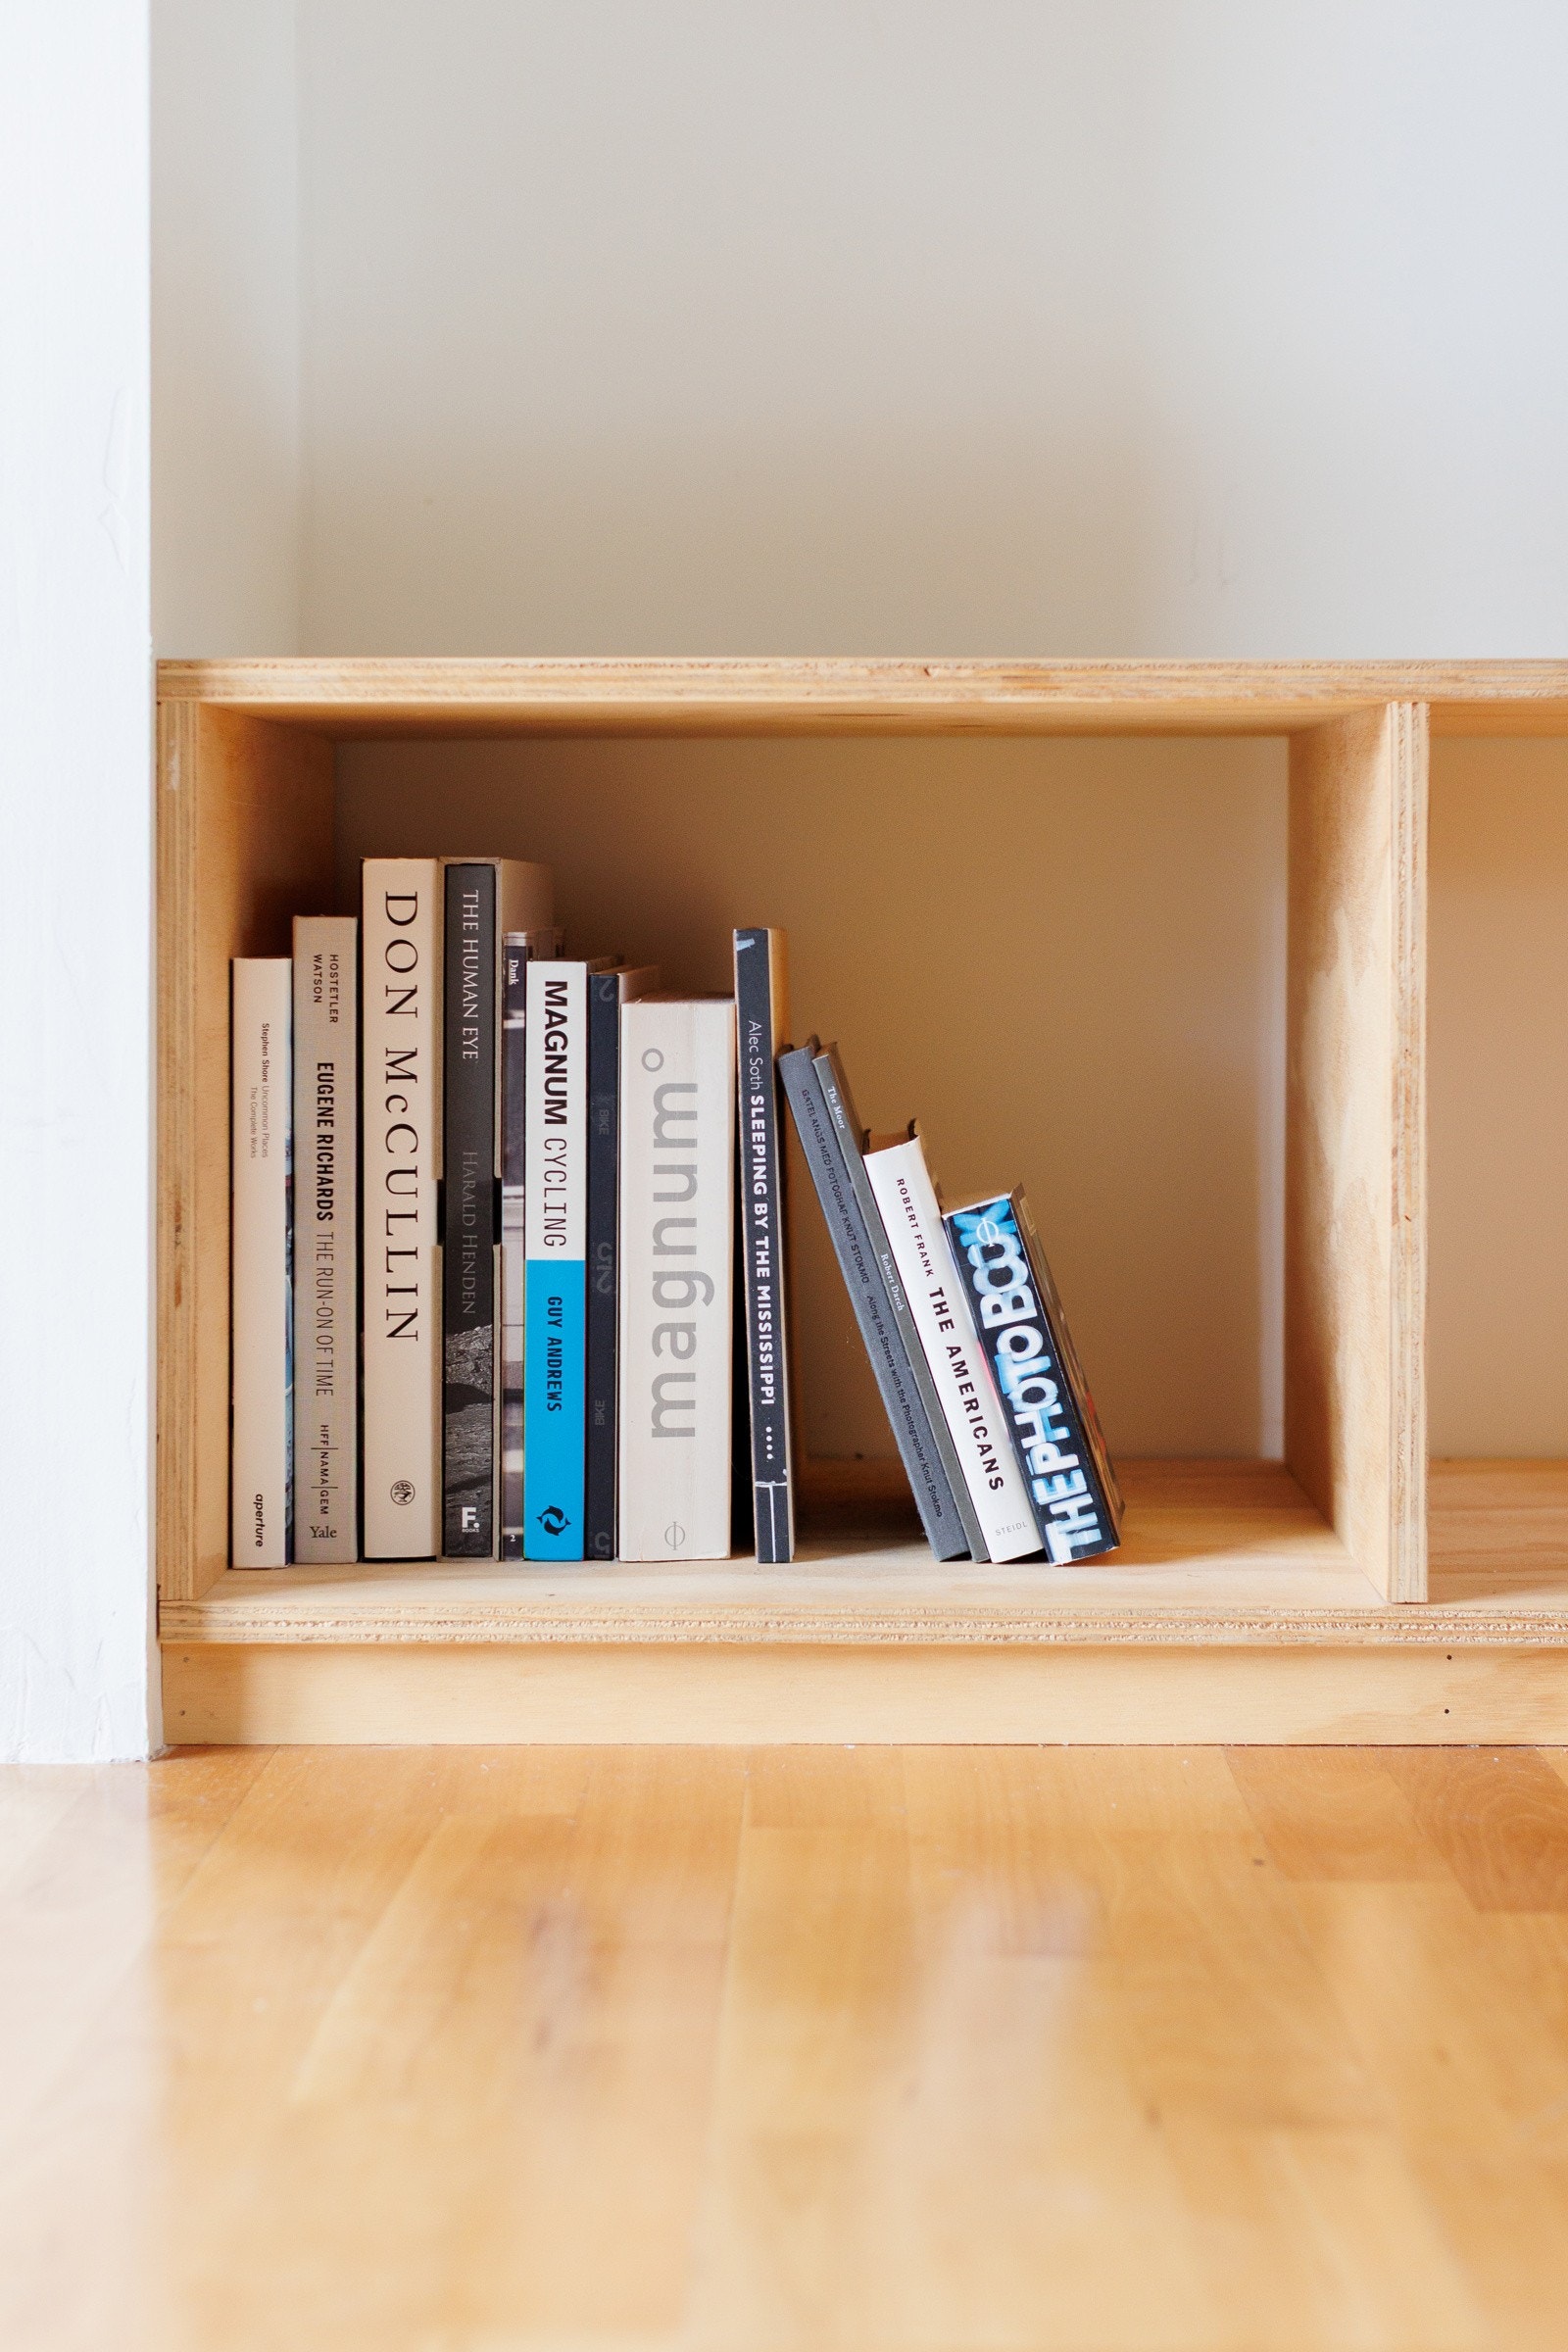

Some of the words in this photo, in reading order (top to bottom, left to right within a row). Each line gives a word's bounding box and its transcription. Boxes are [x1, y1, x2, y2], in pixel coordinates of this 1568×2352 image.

[463, 890, 479, 931] THE
[385, 891, 418, 1018] DON
[508, 958, 519, 986] Dank
[313, 954, 323, 1004] WATSON
[328, 954, 339, 1023] HOSTETLER
[463, 939, 479, 1018] HUMAN
[260, 1022, 270, 1056] Stephen
[463, 1027, 479, 1059] EYE
[544, 980, 568, 1125] MAGNUM
[748, 1019, 763, 1054] Alec
[261, 1059, 270, 1083] Shore
[749, 1056, 764, 1091] Soth
[261, 1084, 270, 1131] Uncommon
[317, 1062, 335, 1128] EUGENE
[827, 1086, 838, 1106] The
[833, 1106, 847, 1130] Moor
[249, 1102, 259, 1136] Complete
[250, 1137, 259, 1159] Works
[261, 1132, 270, 1158] Places
[750, 1094, 768, 1196] SLEEPING
[316, 1134, 335, 1221] RICHARDS
[385, 1047, 418, 1342] McCULLIN
[543, 1138, 567, 1247] CYCLING
[754, 1201, 769, 1230] BY
[818, 1145, 833, 1167] MED
[842, 1215, 858, 1241] KNUT
[851, 1241, 870, 1285] STOKMO
[896, 1178, 919, 1229] ROBERT
[913, 1234, 934, 1278] FRANK
[316, 1231, 334, 1261] THE
[755, 1235, 770, 1278] THE
[316, 1267, 334, 1329] RUN-ON
[880, 1252, 896, 1284] Robert
[891, 1284, 906, 1312] Darch
[547, 1296, 564, 1329] GUY
[866, 1294, 880, 1322] Along
[316, 1335, 334, 1354] OF
[757, 1285, 775, 1405] MISSISSIPPI
[876, 1320, 885, 1337] the
[880, 1336, 897, 1368] Streets
[316, 1359, 334, 1396] TIME
[546, 1336, 563, 1412] ANDREWS
[892, 1367, 904, 1389] with
[929, 1286, 956, 1333] THE
[946, 1344, 1004, 1492] AMERICANS
[897, 1389, 907, 1404] the
[901, 1403, 926, 1461] Photographer
[920, 1460, 934, 1484] Knut
[252, 1494, 266, 1547] aperture
[927, 1483, 943, 1519] Stokmo
[309, 1525, 337, 1539] Yale
[995, 1521, 1028, 1537] STEIDL
